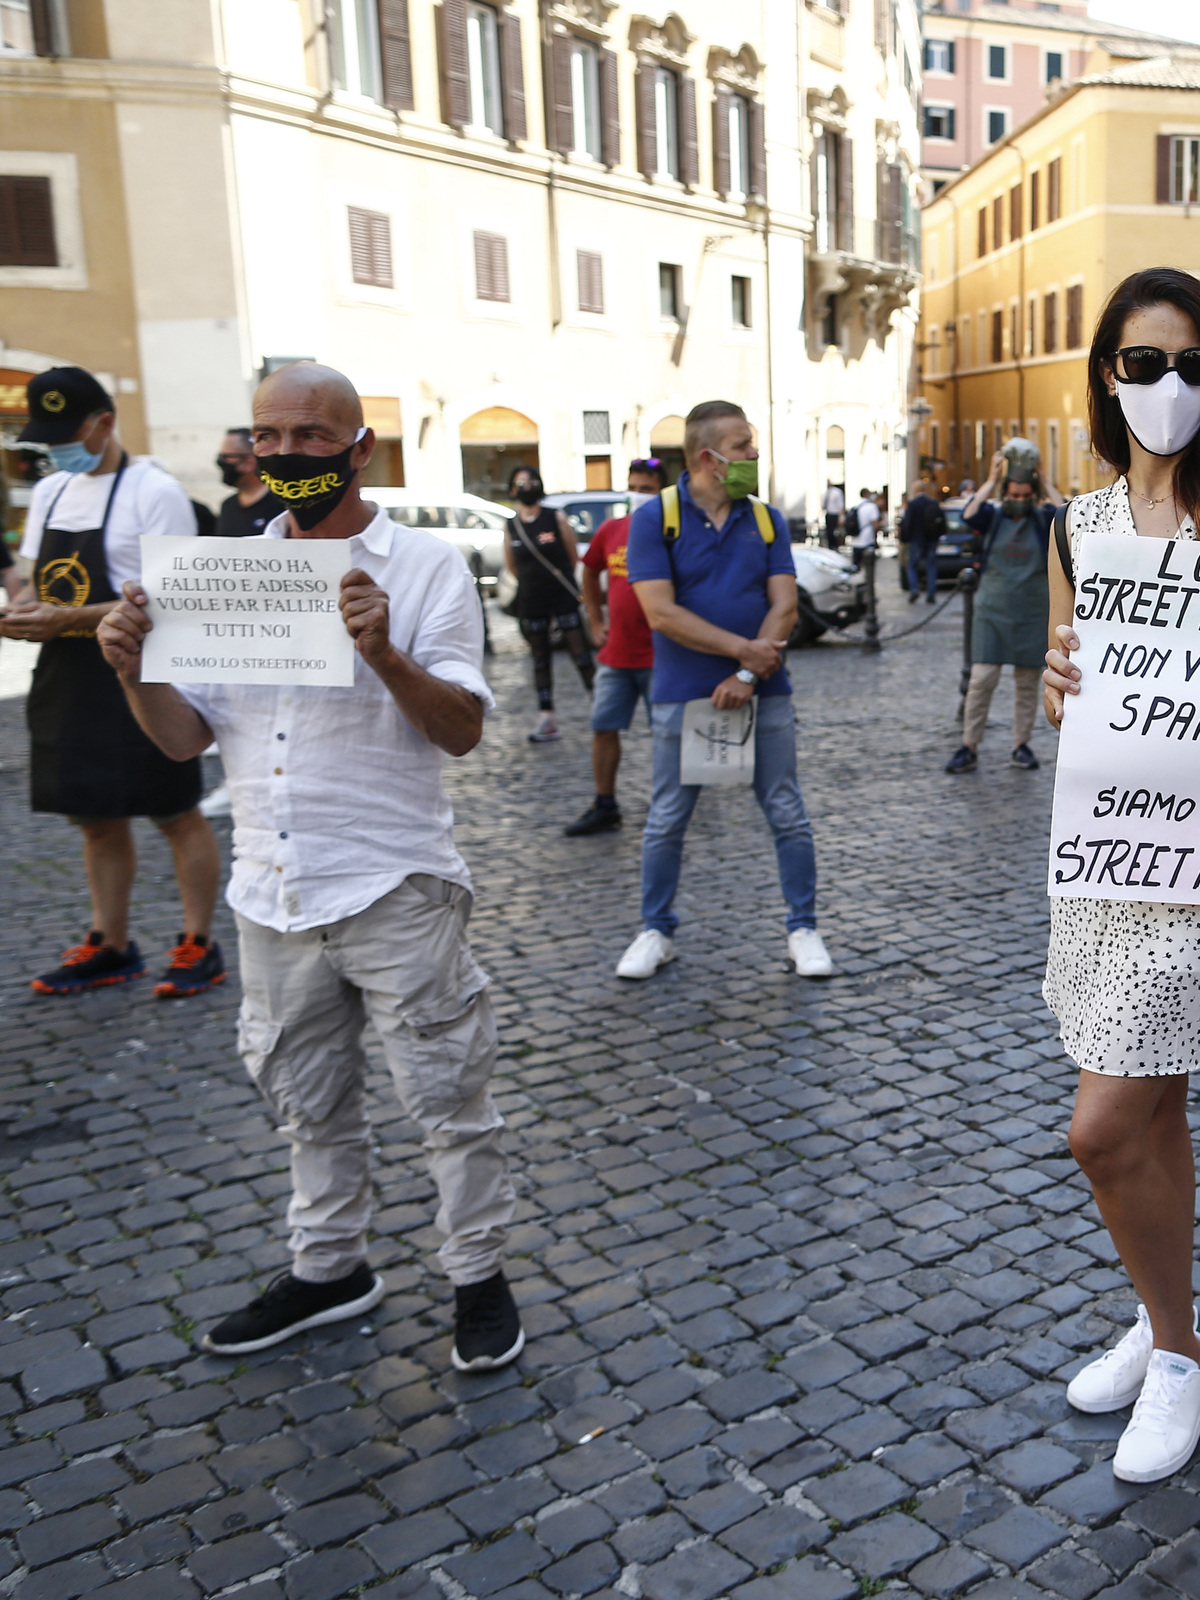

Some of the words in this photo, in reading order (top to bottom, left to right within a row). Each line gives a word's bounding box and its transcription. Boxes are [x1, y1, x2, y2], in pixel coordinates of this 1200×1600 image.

[173, 556, 187, 571] IL
[192, 557, 282, 572] GOVERNO
[287, 559, 313, 573] HA
[162, 577, 236, 592] FALLITO
[242, 578, 253, 592] E
[257, 579, 328, 593] ADESSO
[156, 597, 220, 611] VUOLE
[225, 598, 258, 612] FAR
[265, 599, 337, 613] FALLIRE
[1075, 573, 1200, 629] STREET
[203, 623, 255, 637] TUTTI
[261, 624, 291, 638] NOI
[171, 656, 217, 669] SIAMO
[220, 657, 239, 669] LO
[242, 657, 327, 670] STREETFOOD
[1099, 643, 1172, 679] NON
[1094, 786, 1196, 822] SIAMO
[1055, 835, 1194, 889] STREET
